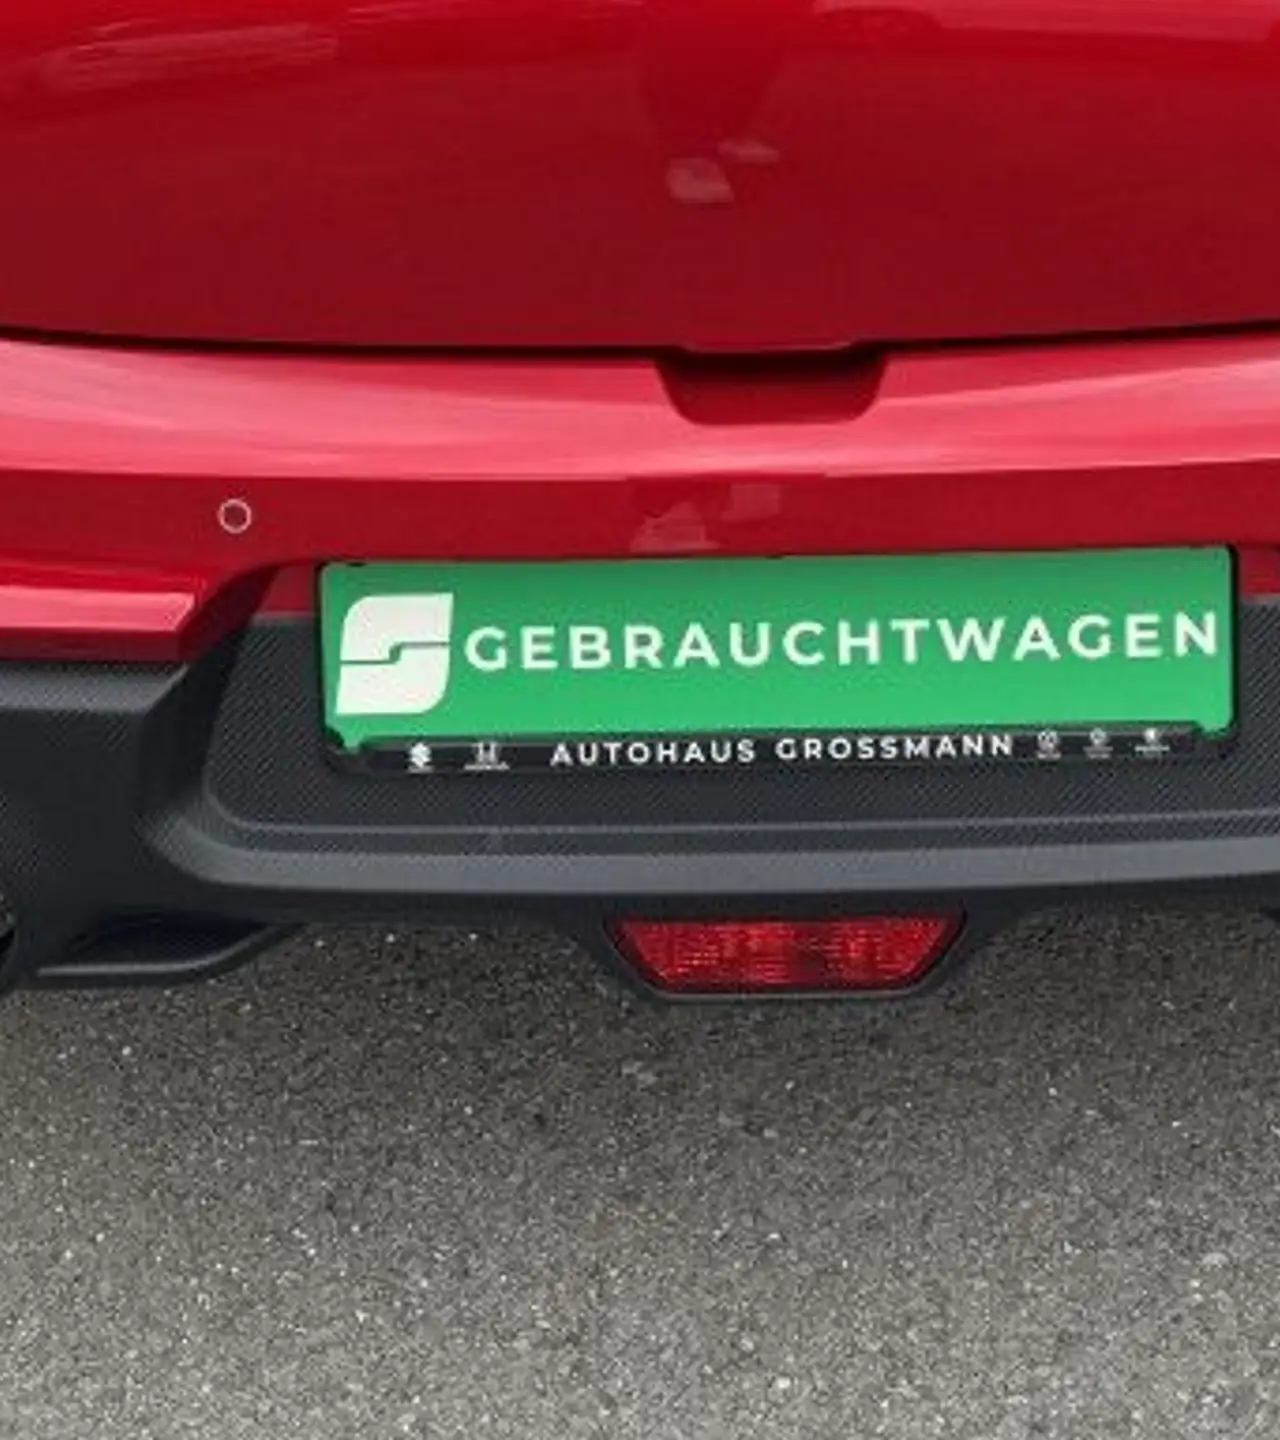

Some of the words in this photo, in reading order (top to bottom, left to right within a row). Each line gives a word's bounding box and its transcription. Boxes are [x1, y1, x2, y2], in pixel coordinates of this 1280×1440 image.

[462, 610, 1219, 673] GEBRAUCHTWAGEN
[548, 737, 757, 768] AUTOHAUS
[774, 732, 1015, 762] GROSSMANN
